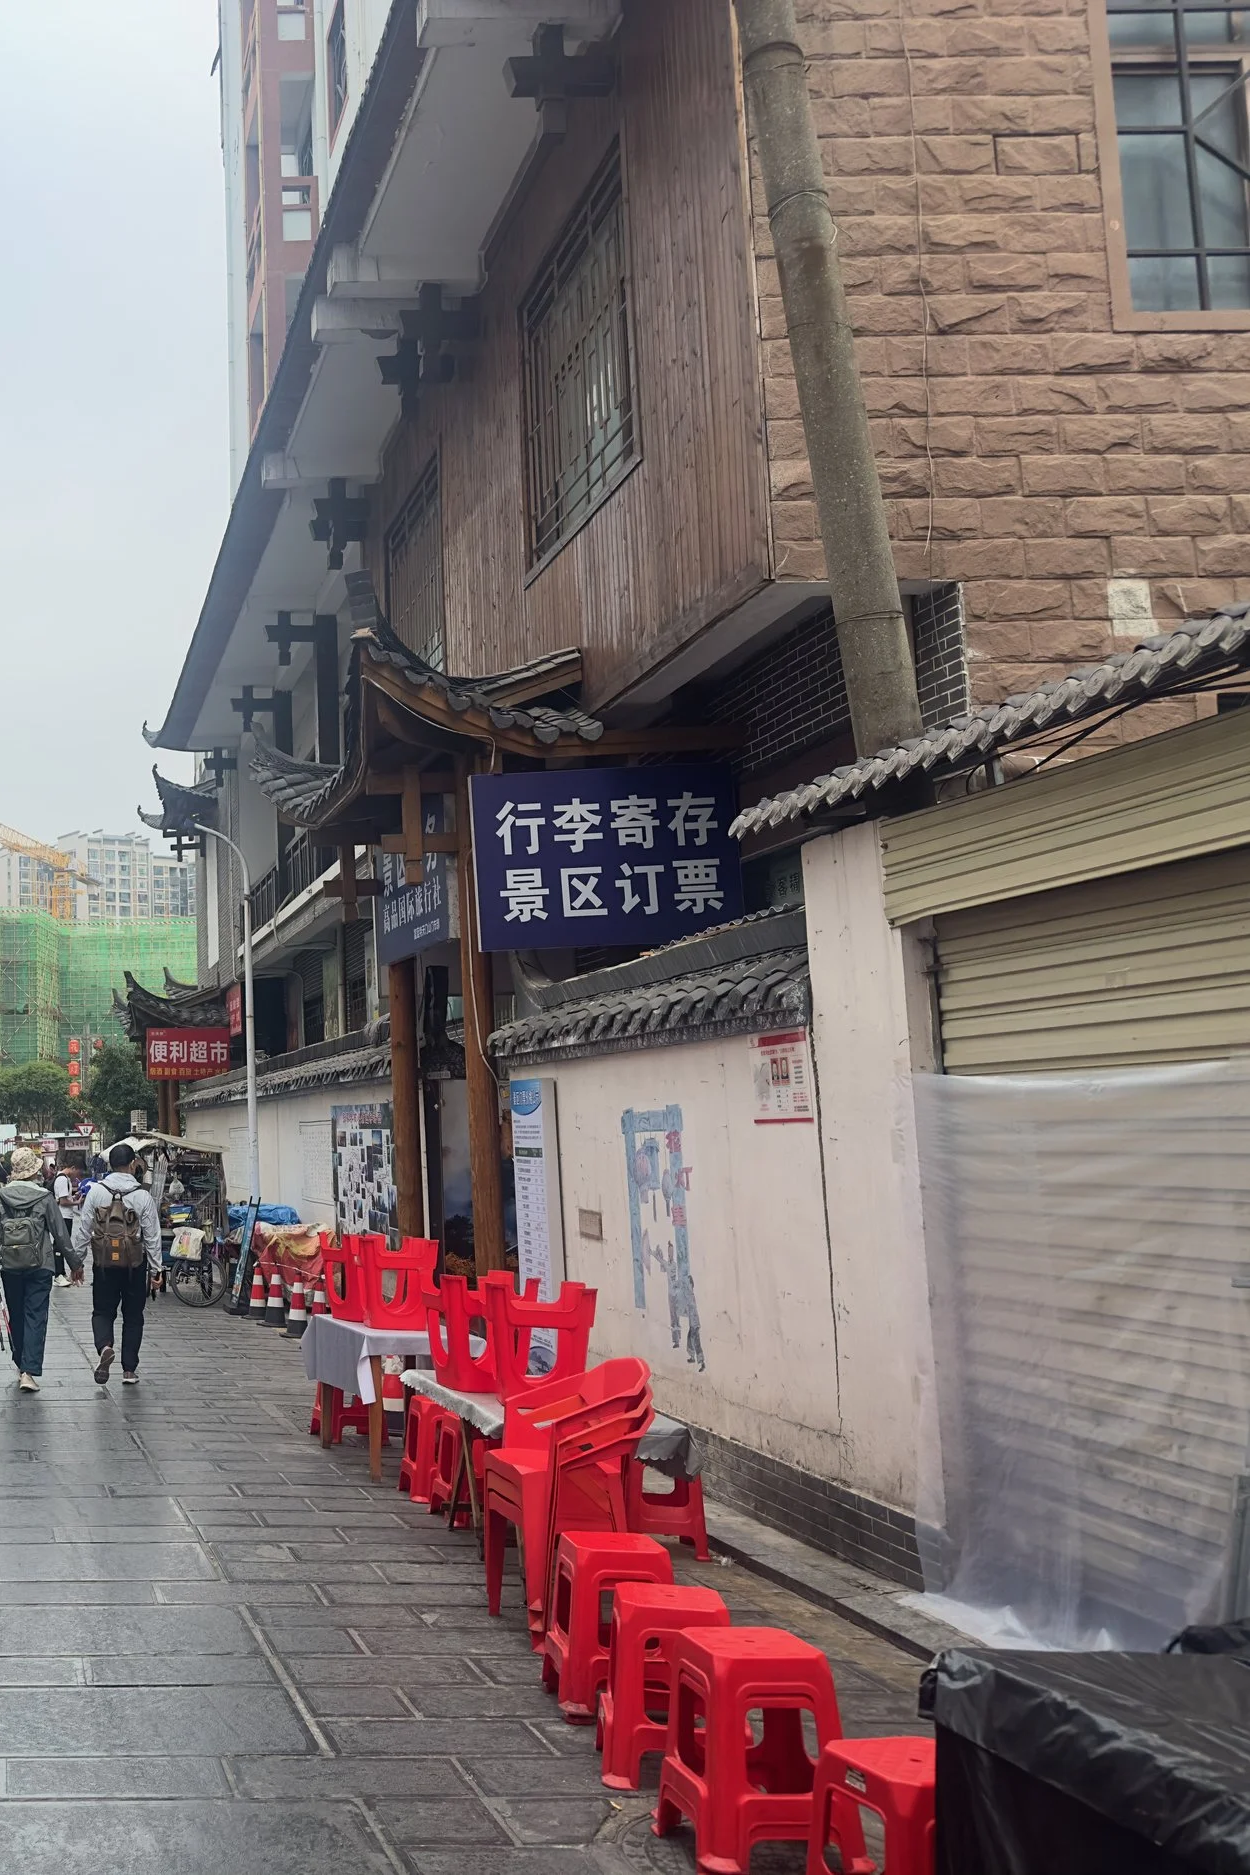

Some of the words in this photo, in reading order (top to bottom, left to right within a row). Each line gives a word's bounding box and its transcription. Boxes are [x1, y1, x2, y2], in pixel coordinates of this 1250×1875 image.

[495, 791, 718, 855] 行李寄存
[382, 875, 442, 935] 高品国际旅行社
[499, 858, 725, 923] 景区订票
[150, 1040, 228, 1064] 便利超市
